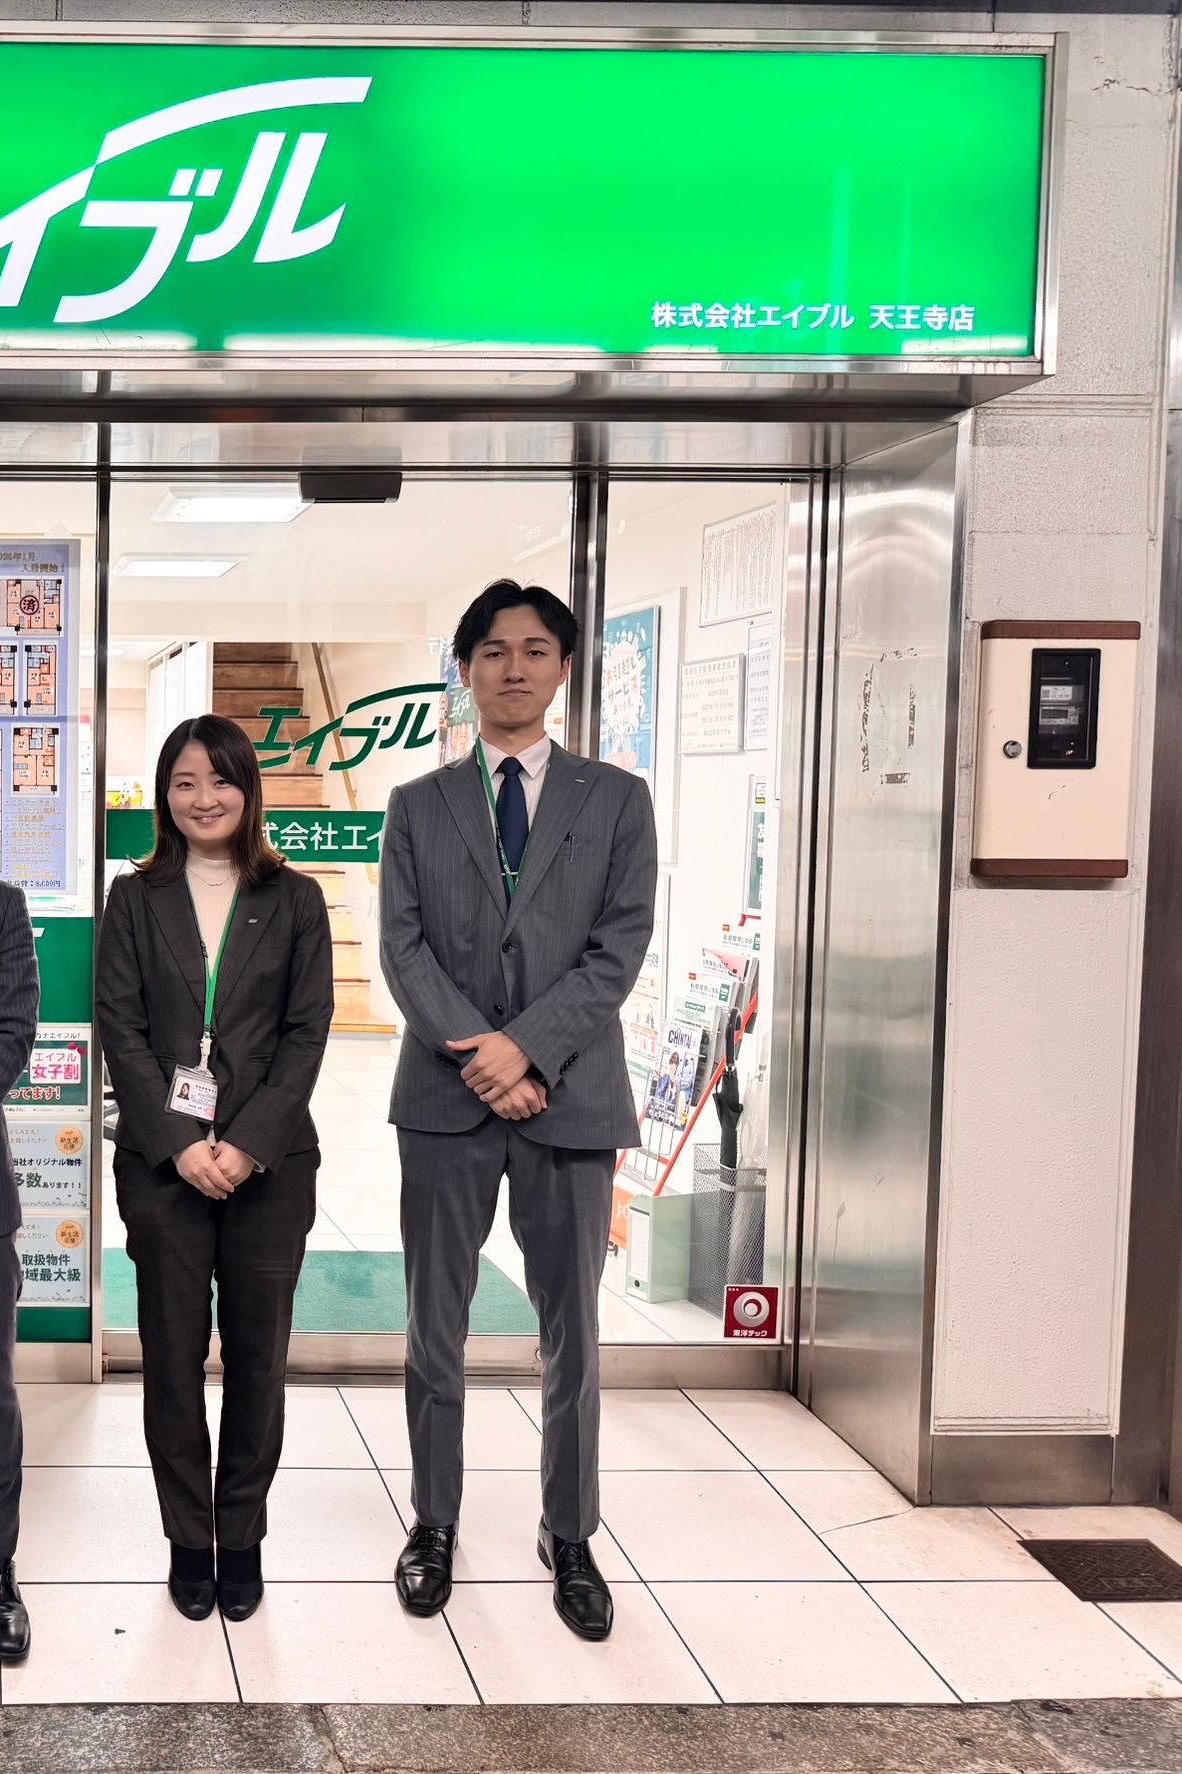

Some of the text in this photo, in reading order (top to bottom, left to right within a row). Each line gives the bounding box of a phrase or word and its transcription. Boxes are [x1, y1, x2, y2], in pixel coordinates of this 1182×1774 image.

[651, 301, 977, 332] 株式会社エイブル 天王寺店
[21, 597, 37, 613] 済
[252, 683, 448, 771] エイブル
[32, 1063, 79, 1080] 女子割
[13, 1157, 83, 1166] 当社オリジナル物件
[21, 1253, 71, 1266] 取扱物件
[21, 1268, 81, 1282] 域最大級
[733, 1329, 768, 1337] 東洋テック
